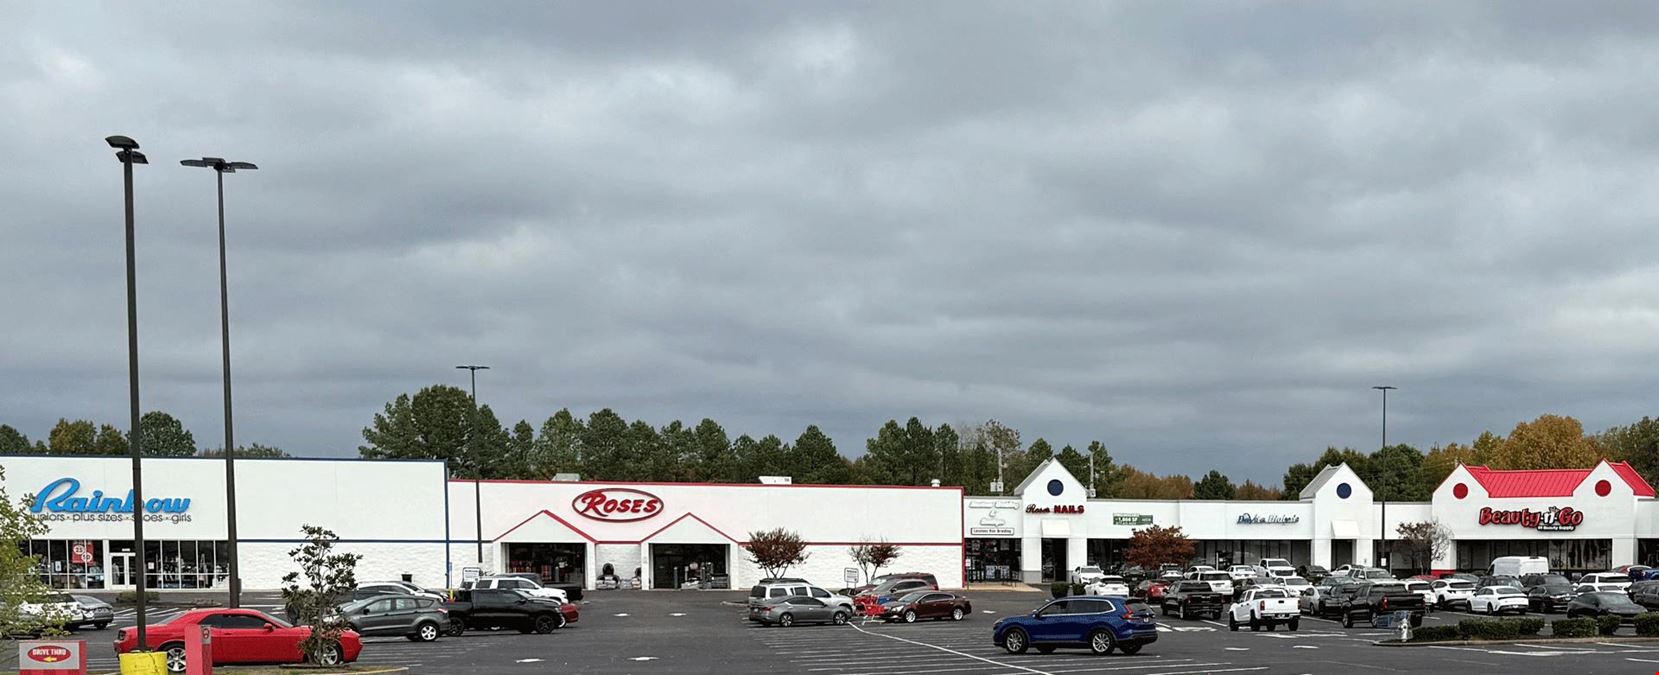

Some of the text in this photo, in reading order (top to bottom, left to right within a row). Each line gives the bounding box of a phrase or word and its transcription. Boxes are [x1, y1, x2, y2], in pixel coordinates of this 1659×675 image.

[580, 491, 659, 517] ROSES
[1053, 505, 1085, 514] NAILS
[73, 511, 95, 523] plus
[97, 512, 123, 522] sizes
[171, 511, 192, 524] girls
